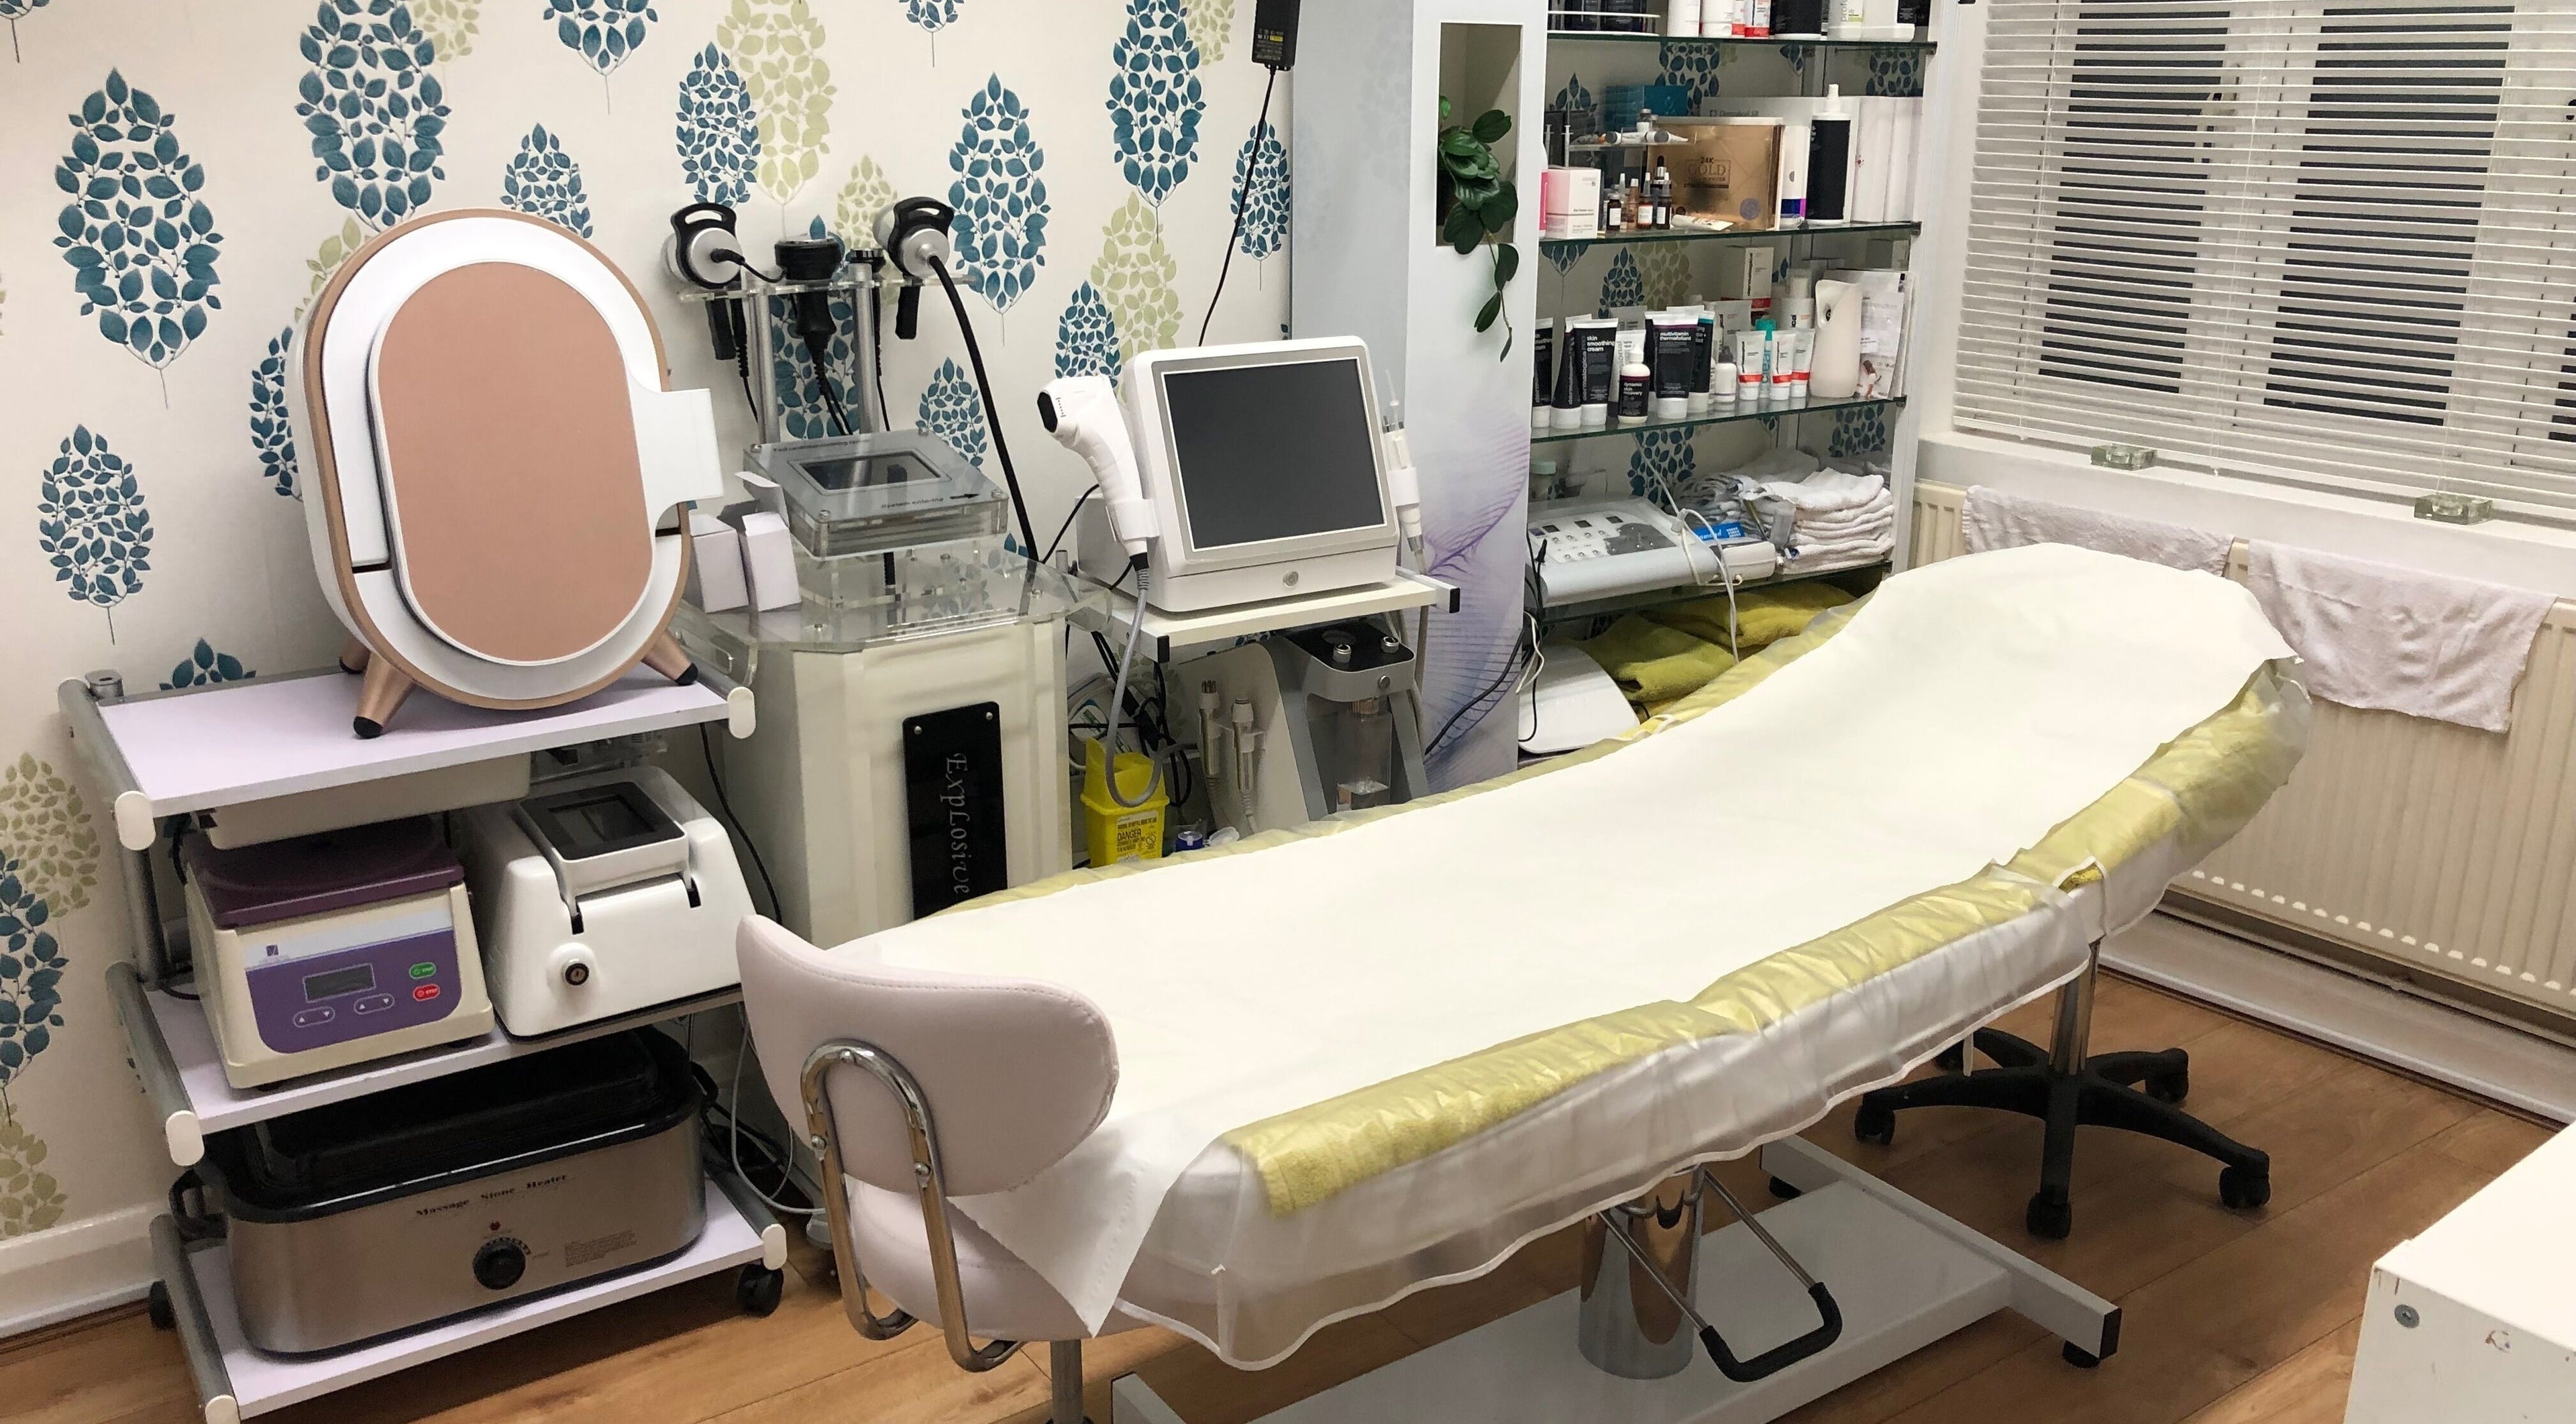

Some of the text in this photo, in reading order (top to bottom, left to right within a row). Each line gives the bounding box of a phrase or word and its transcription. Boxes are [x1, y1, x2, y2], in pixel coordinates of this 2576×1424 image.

[1688, 164, 1726, 175] GOLD
[1117, 828, 1142, 842] DANGER
[416, 1174, 568, 1217] Massage Stone Heater
